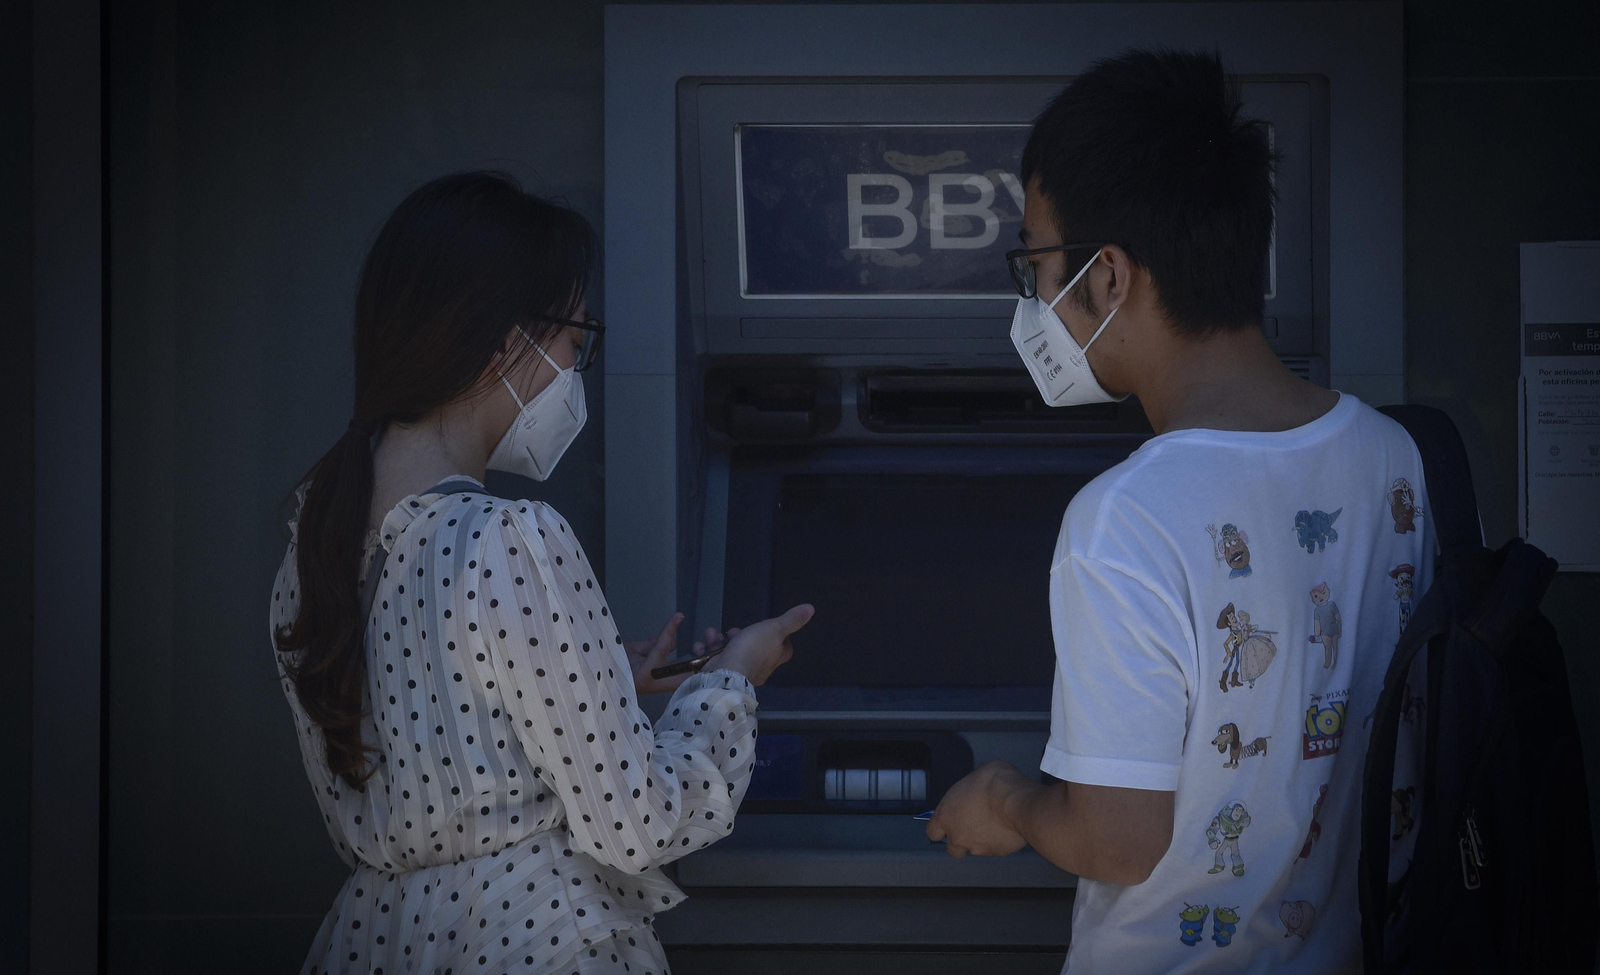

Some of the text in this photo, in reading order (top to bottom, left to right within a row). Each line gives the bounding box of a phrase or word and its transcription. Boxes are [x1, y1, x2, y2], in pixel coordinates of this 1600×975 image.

[847, 173, 1025, 249] BB
[1533, 331, 1562, 341] BBVA
[1586, 328, 1600, 338] Es
[1554, 368, 1594, 376] activación
[1542, 378, 1560, 386] esta
[1561, 377, 1588, 386] oficina
[1534, 471, 1557, 479] Disculpe
